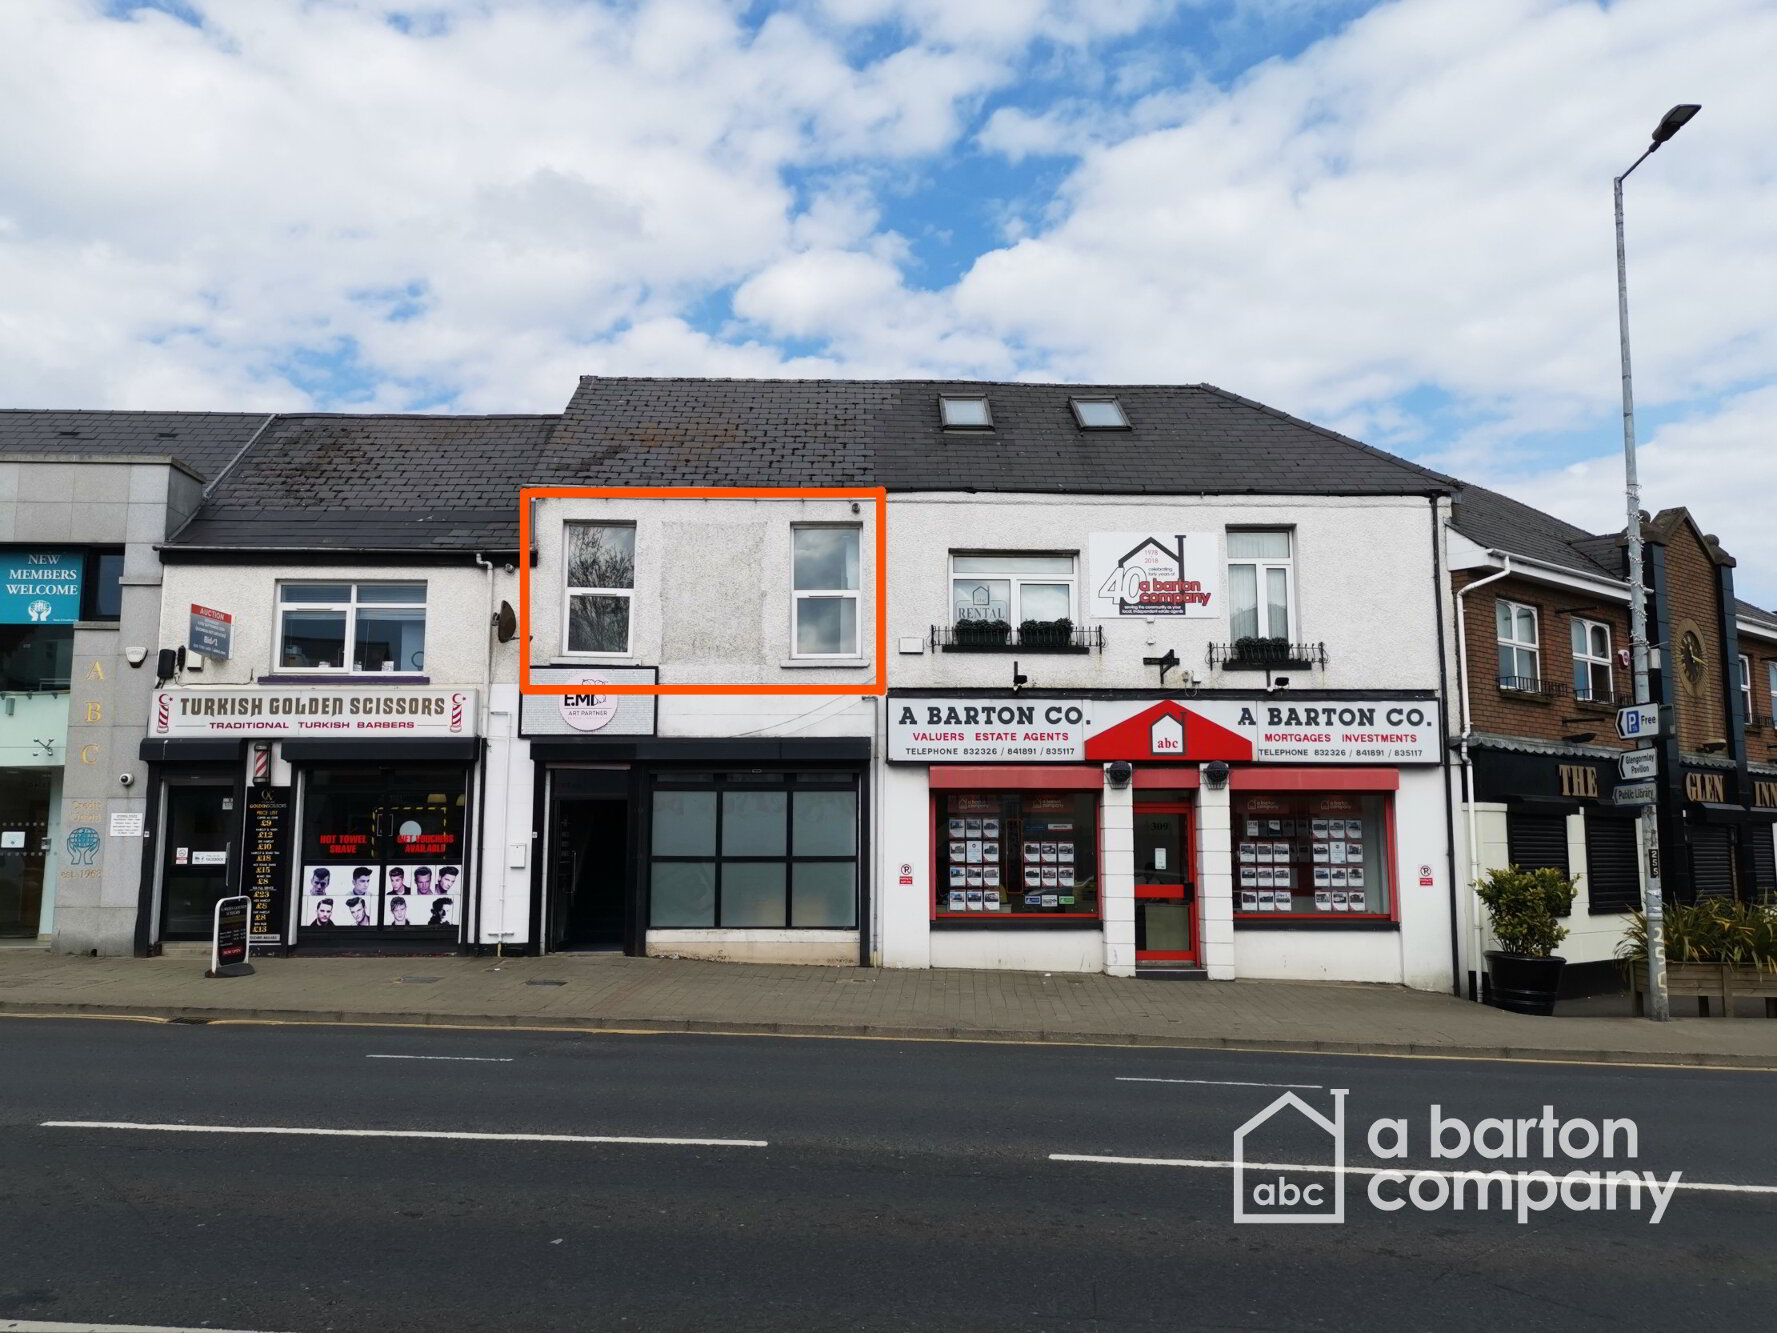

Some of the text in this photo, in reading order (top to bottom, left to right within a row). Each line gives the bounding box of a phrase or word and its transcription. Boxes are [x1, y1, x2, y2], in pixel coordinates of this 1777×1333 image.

[28, 554, 61, 565] NEW
[9, 569, 77, 580] MEMBERS
[6, 584, 78, 595] WELCOME
[1098, 566, 1147, 605] 40
[1139, 578, 1201, 592] a barton
[1139, 593, 1211, 606] company
[199, 607, 225, 621] AUCTION
[958, 607, 1005, 619] RENTAL
[87, 661, 104, 680] A
[85, 702, 102, 722] B
[180, 697, 445, 717] TURKISH GOLDEN SCISSORS
[898, 706, 1091, 725] A BARTON CO.
[1238, 708, 1432, 727] A BARTON CO.
[1641, 715, 1656, 725] Free
[298, 721, 349, 729] TURKISH
[357, 721, 415, 729] BARBERS
[912, 732, 1069, 742] VALUERS ESTATE AGENTS
[1157, 738, 1178, 748] abc
[1264, 733, 1417, 743] MORTGAGES INVESTMENTS
[80, 744, 99, 765] C
[1356, 749, 1385, 757] 841891
[1394, 749, 1423, 757] 835117
[1631, 765, 1649, 774] Pavilion
[1559, 764, 1777, 808] THE GLEN INN
[1618, 788, 1653, 800] Public Library
[320, 835, 367, 844] HOT TOWEL
[330, 845, 356, 853] SHAVE
[404, 844, 446, 853] AVAILABLE
[1651, 850, 1659, 875] 255
